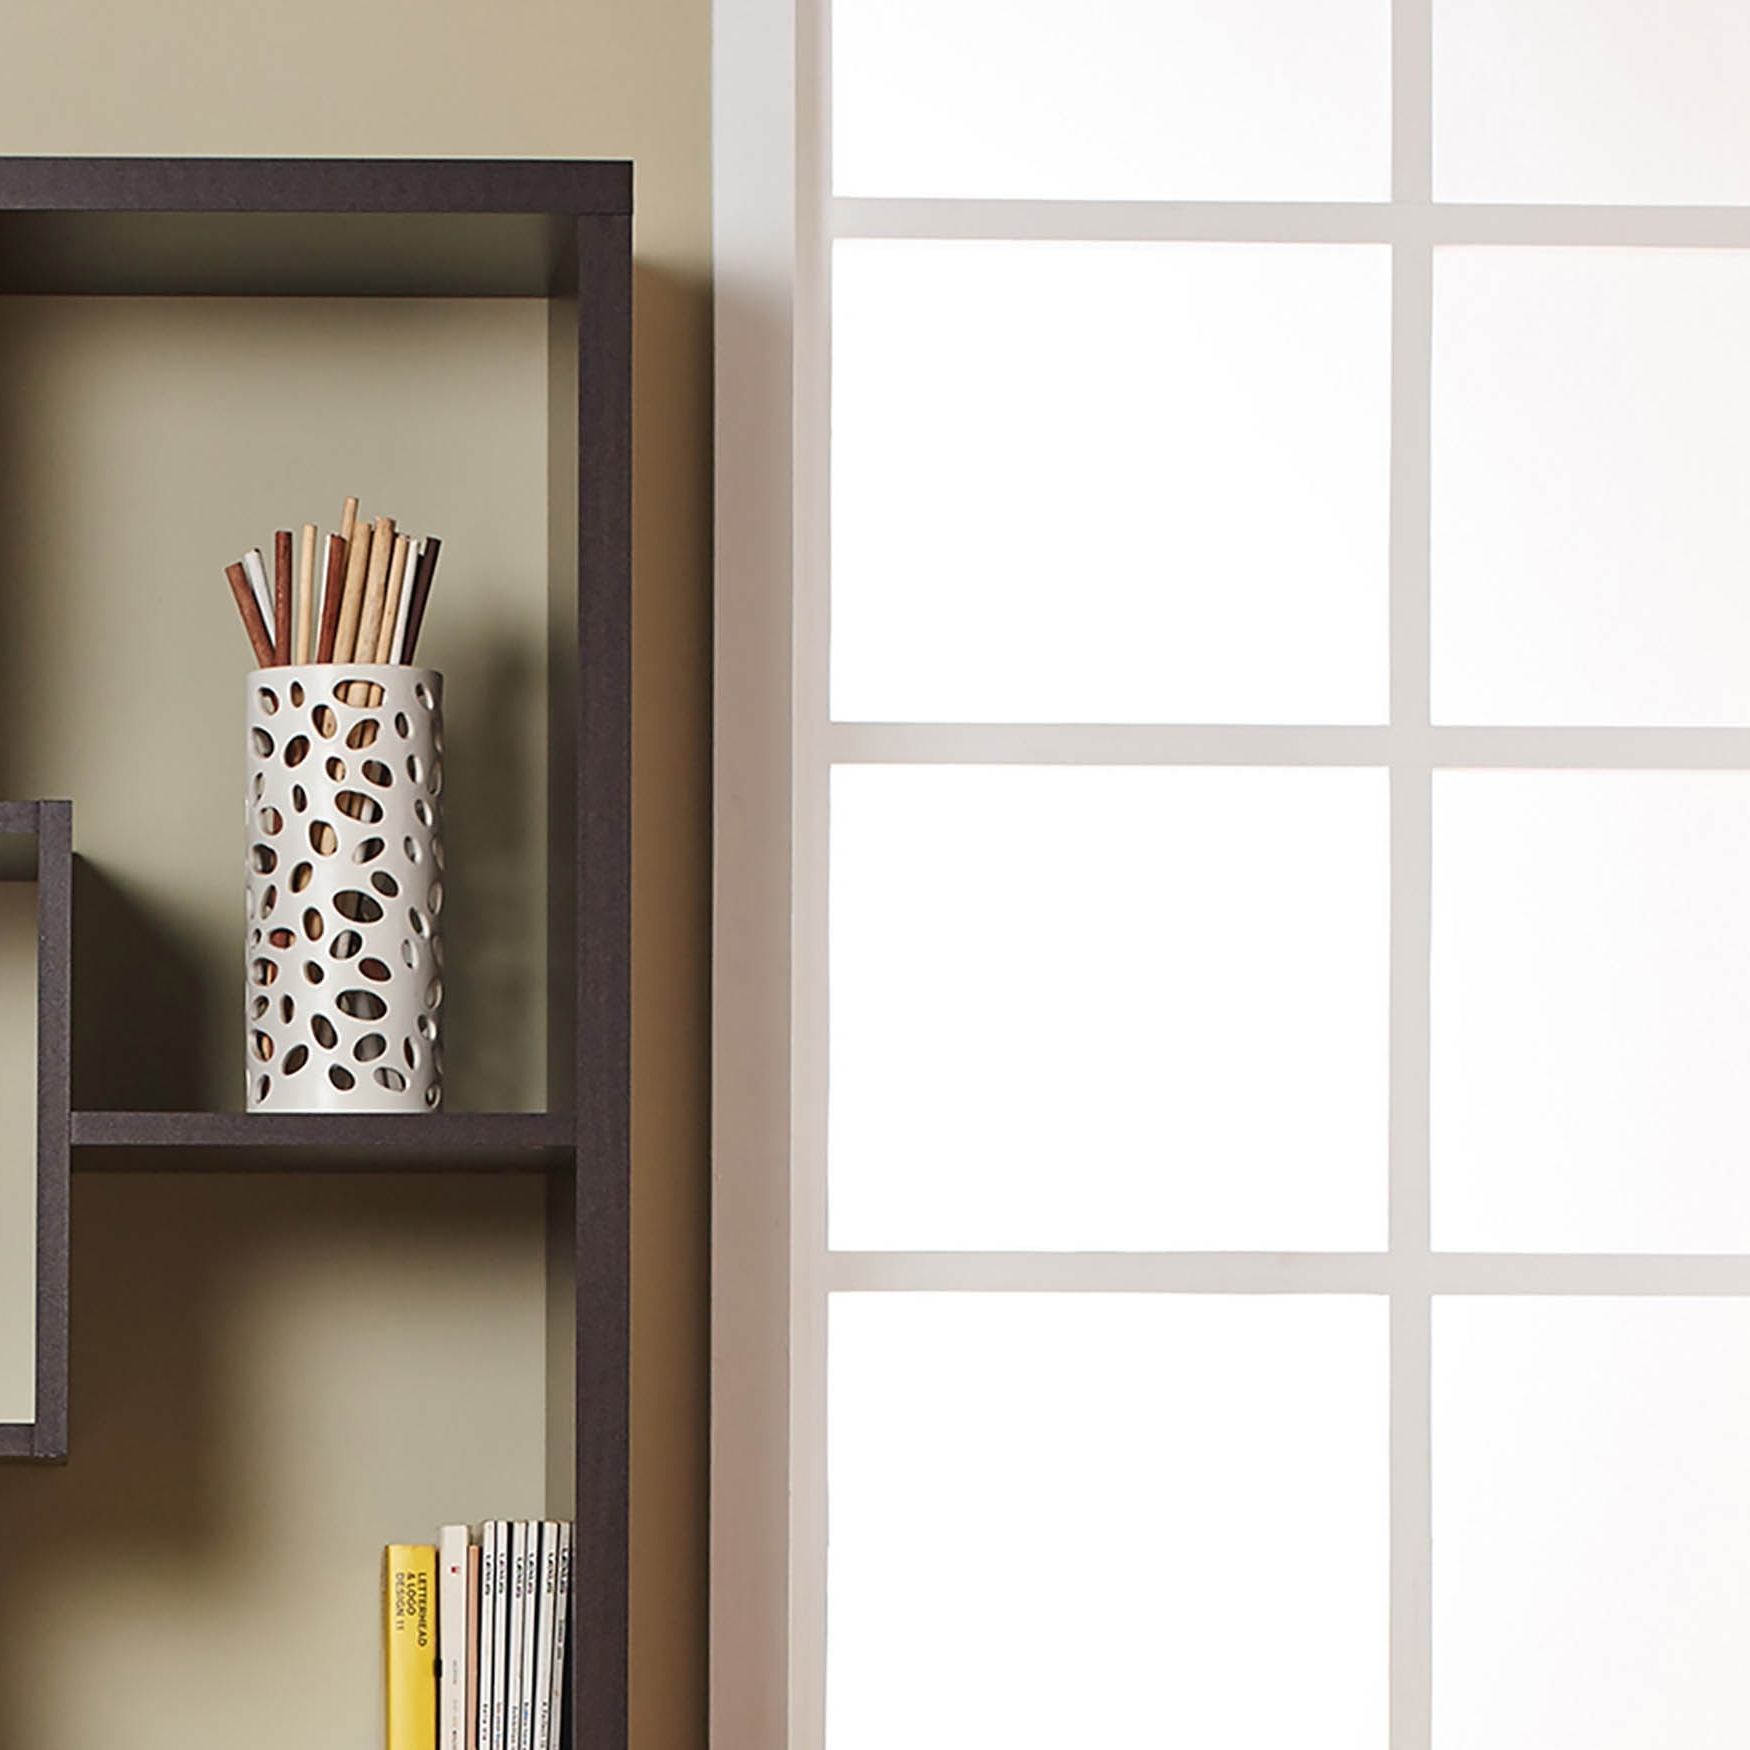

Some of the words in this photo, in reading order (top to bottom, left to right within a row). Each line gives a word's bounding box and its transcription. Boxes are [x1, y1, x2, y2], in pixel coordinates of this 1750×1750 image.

[395, 1572, 405, 1617] DESIGN
[406, 1582, 417, 1616] LOGO
[417, 1572, 428, 1647] LETTERHEAD
